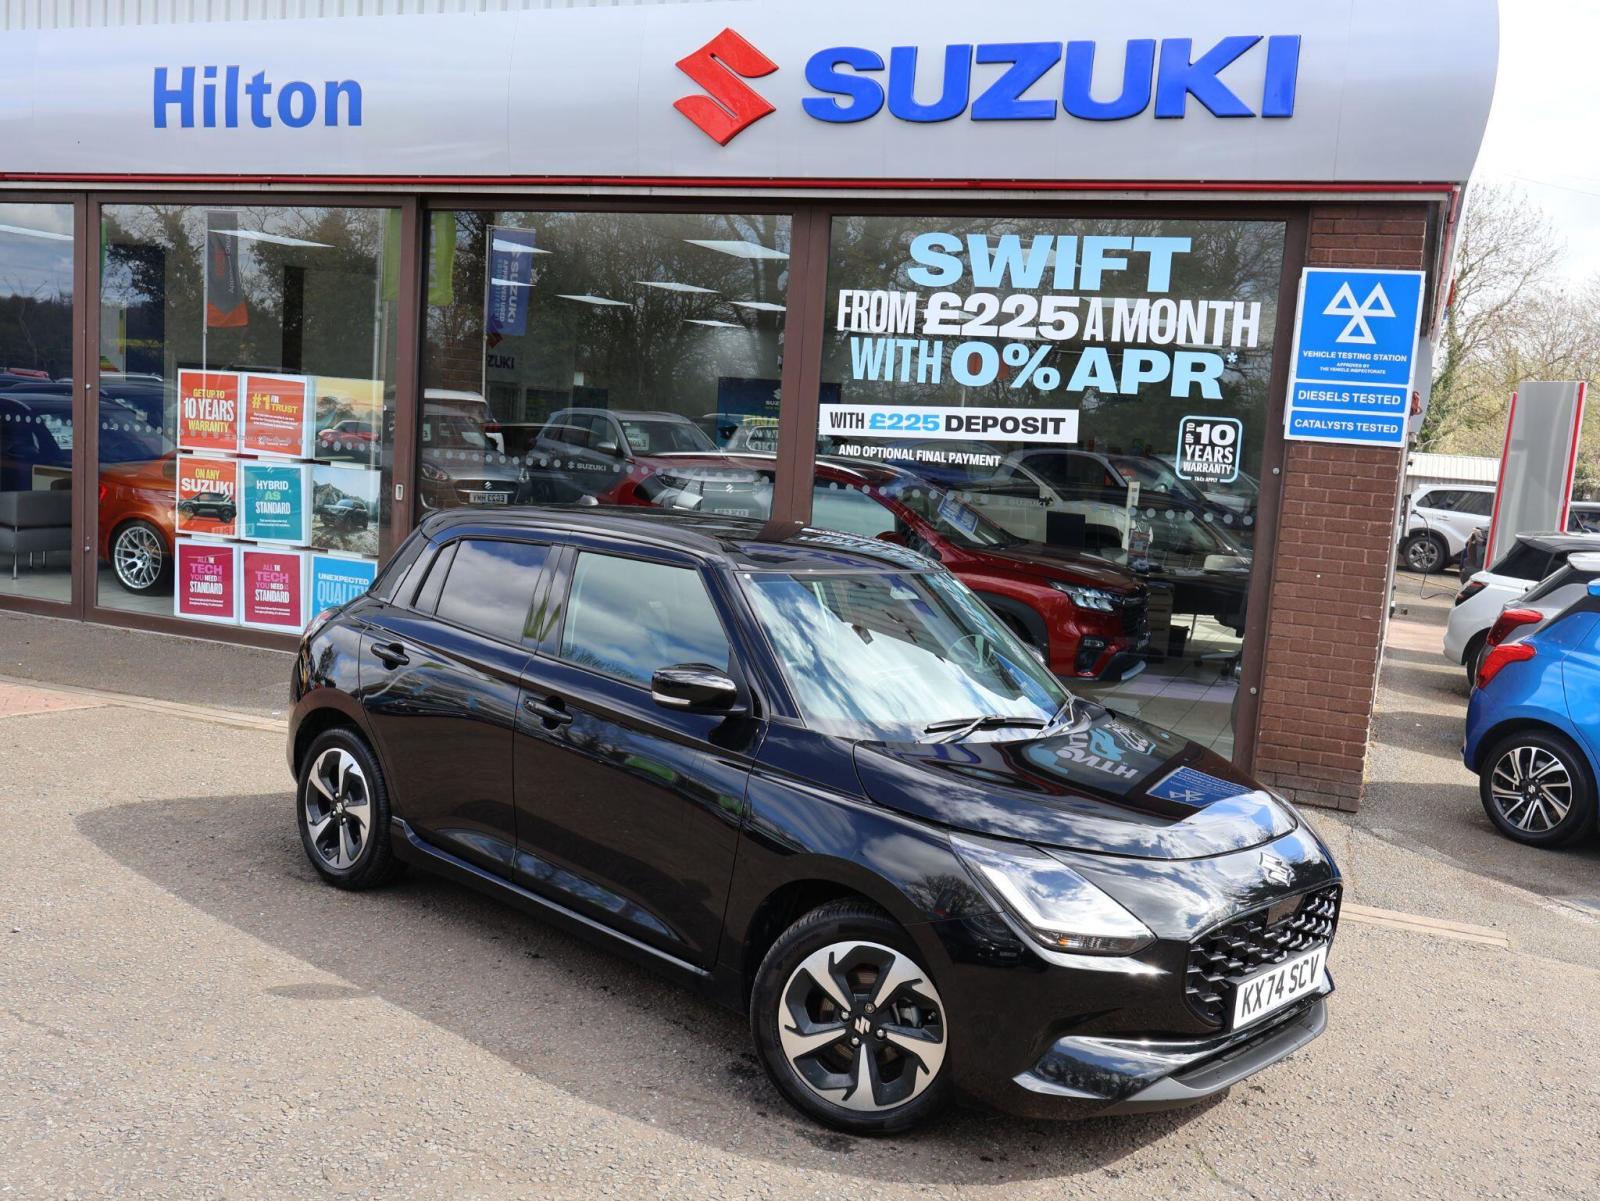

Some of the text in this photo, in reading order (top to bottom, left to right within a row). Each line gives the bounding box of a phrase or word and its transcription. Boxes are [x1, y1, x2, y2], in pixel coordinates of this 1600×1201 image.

[802, 35, 1301, 123] SUZUKI
[154, 65, 362, 128] Hilton
[907, 232, 1192, 292] SWIFT
[507, 260, 519, 324] SUZUKI
[837, 289, 1261, 348] FROM £225 A MONTH
[1303, 350, 1407, 362] VEHICLE TESTING STATION
[850, 337, 942, 384] WITH
[950, 340, 1061, 391] 0%
[193, 388, 225, 398] GET UP TO
[1298, 390, 1401, 405] DIESELS TESTED
[252, 392, 271, 410] #1
[183, 397, 235, 421] 10 YEARS
[272, 404, 298, 413] TRUST
[188, 420, 230, 432] WARRANTY
[830, 411, 1066, 435] WITH £225 DEPOSIT
[1294, 419, 1399, 433] CATALYSTS TESTED
[1185, 422, 1195, 443] UP TO
[1196, 423, 1235, 446] 10
[838, 444, 1001, 467] AND OPTIONAL FINAL PAYMENT
[1185, 444, 1234, 463] YEARS
[195, 468, 220, 480] ON ANY
[576, 463, 607, 471] SUZUKI
[1183, 461, 1232, 475] WARRANTY
[181, 477, 234, 496] SUZUKI
[256, 480, 289, 490] HYBRID
[264, 491, 281, 501] AS
[255, 501, 291, 514] STANDARD
[189, 563, 223, 575] TECH
[255, 571, 289, 583] TECH
[318, 572, 369, 585] UNEXPECTED
[189, 581, 223, 595] STANDARD
[255, 589, 290, 603] STANDARD
[1241, 953, 1320, 1018] KX74 SCV
